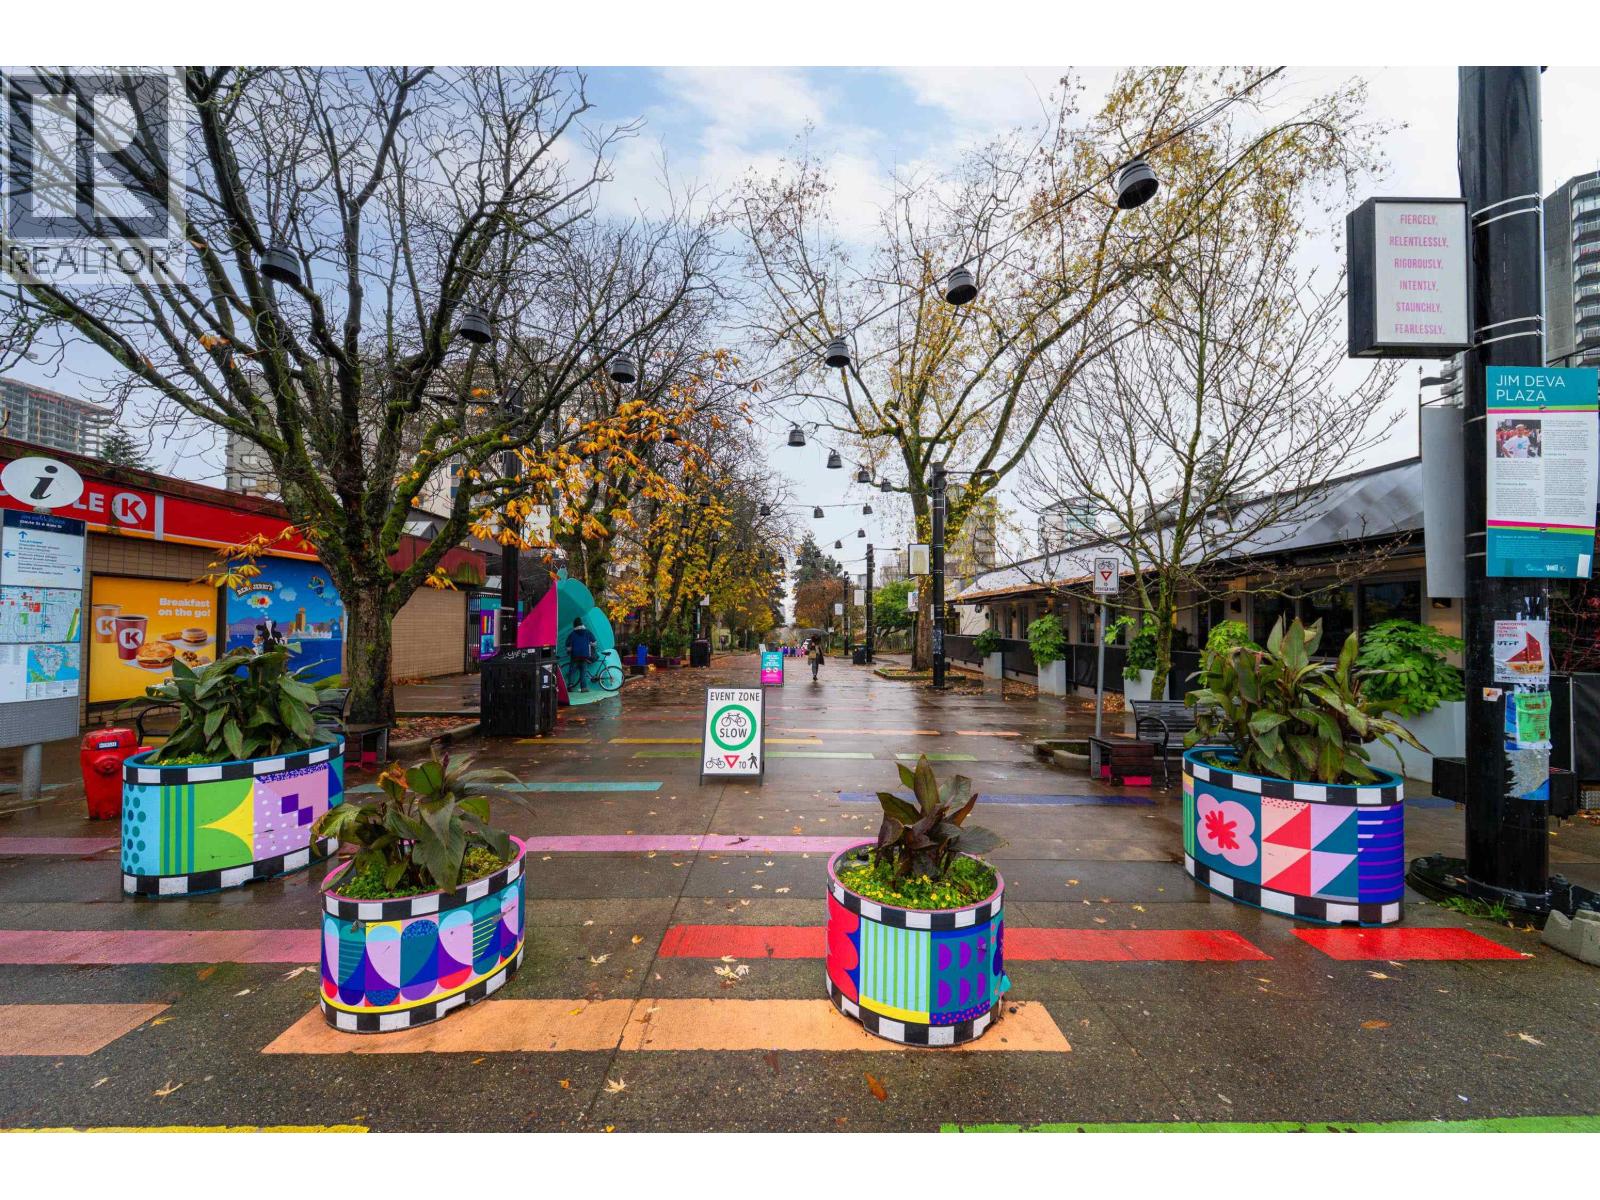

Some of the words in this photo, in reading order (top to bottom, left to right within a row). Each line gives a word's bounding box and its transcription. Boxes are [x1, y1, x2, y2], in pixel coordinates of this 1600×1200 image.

[1496, 375, 1520, 387] JIM
[1524, 375, 1566, 388] DEVA
[1496, 389, 1547, 402] PLAZA
[30, 465, 58, 500] i
[159, 597, 210, 607] Breakfast
[175, 608, 192, 616] the
[195, 609, 211, 618] go!
[710, 692, 735, 701] EVENT
[738, 692, 760, 701] ZONE
[719, 728, 748, 738] SLOW
[738, 761, 747, 769] TO
